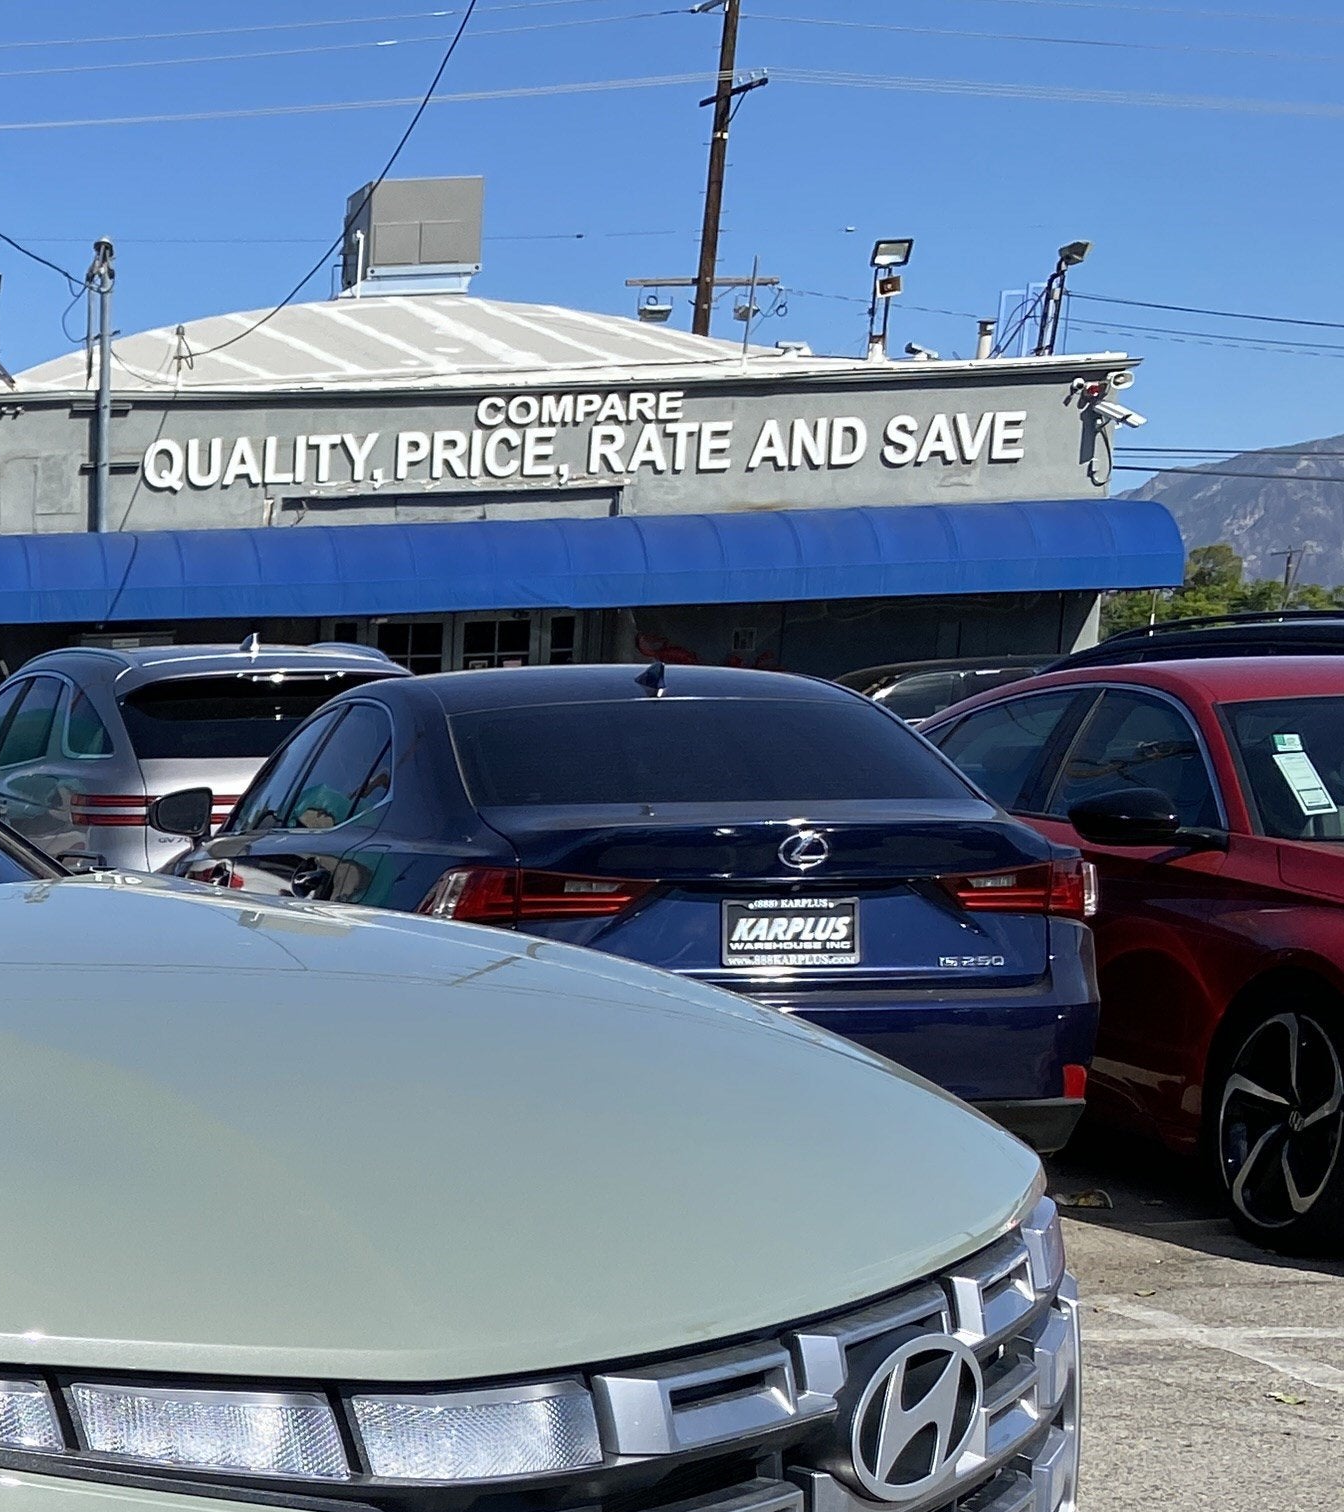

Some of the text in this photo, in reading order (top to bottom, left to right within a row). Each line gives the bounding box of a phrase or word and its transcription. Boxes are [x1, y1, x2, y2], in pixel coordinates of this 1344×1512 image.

[476, 391, 685, 427] COMPARE
[142, 410, 1028, 492] QUALITY, PRICE, RATE AND SAVE
[780, 898, 828, 909] KARPLUS
[731, 916, 851, 941] KARPLUS
[729, 941, 822, 950] WAREHOUSE
[962, 955, 1005, 967] 250
